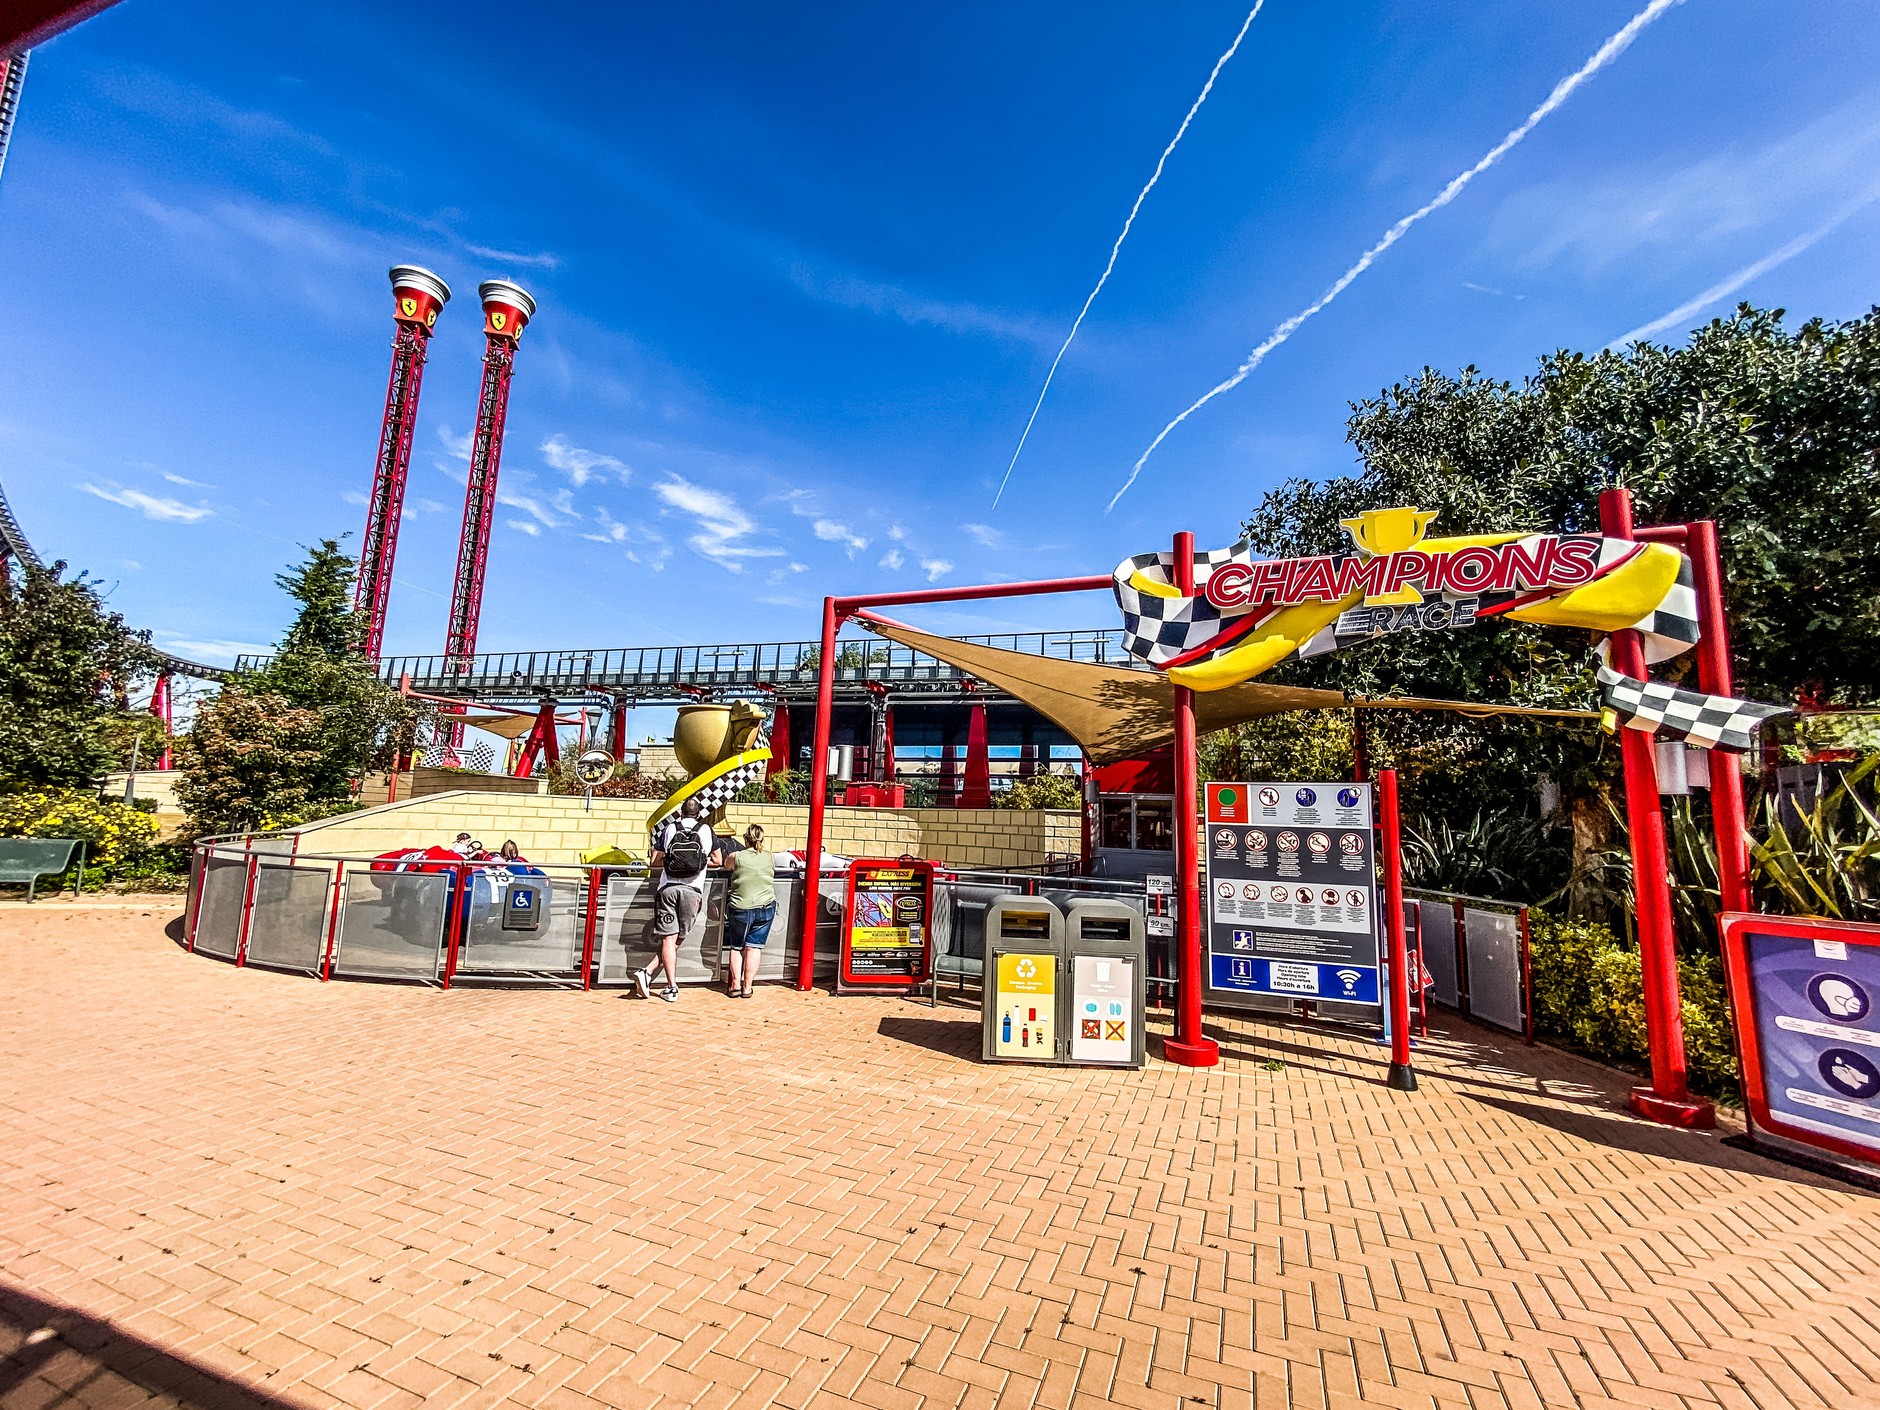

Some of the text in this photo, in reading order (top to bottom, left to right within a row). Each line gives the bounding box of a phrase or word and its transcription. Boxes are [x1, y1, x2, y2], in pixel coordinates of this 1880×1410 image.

[1205, 537, 1600, 609] CHAMPIONS
[1366, 598, 1480, 634] RACE
[1150, 919, 1160, 927] 90
